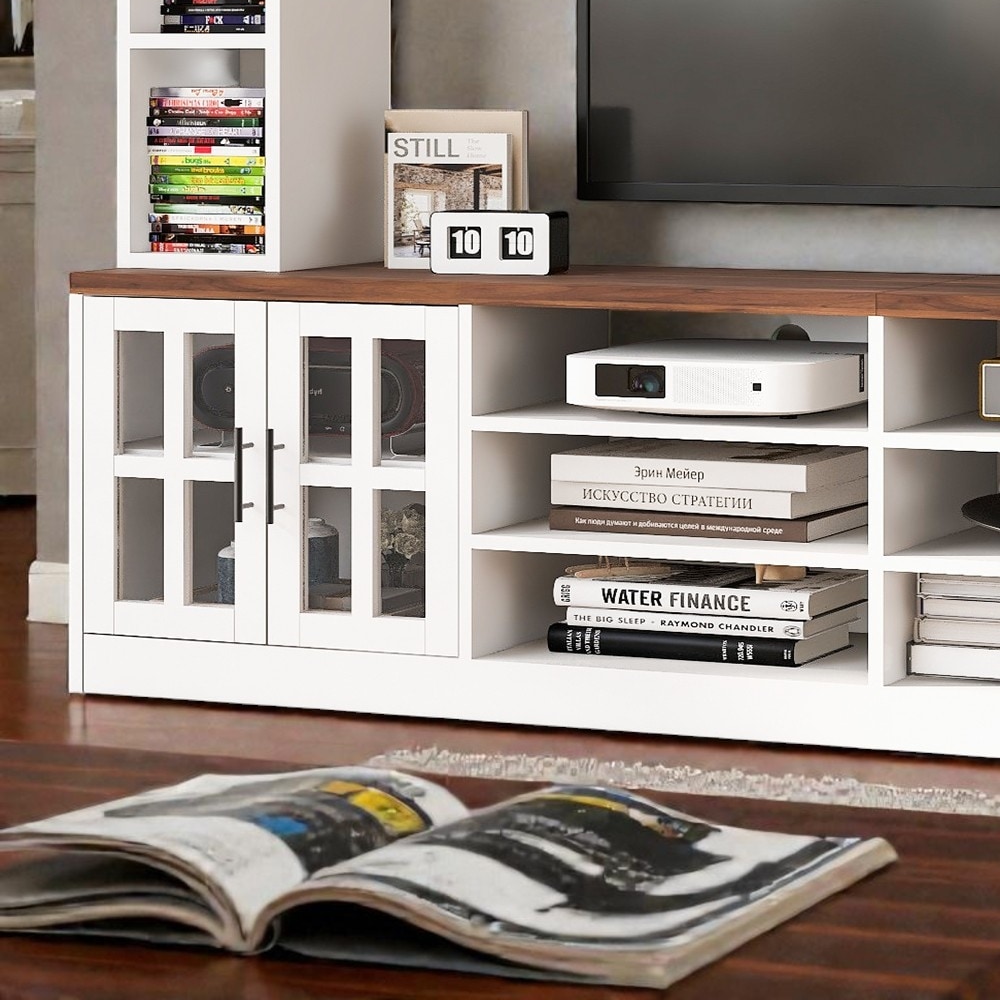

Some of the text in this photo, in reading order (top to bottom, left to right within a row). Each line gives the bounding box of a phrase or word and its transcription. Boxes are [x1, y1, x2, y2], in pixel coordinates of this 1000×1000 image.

[393, 138, 460, 158] STILL
[452, 229, 533, 256] 10 10
[634, 466, 705, 483] Эрин Мейер
[582, 488, 753, 510] ИСКУССТВО СТРАТЕГИИ
[574, 516, 587, 525] Как
[588, 518, 605, 527] люди
[606, 519, 632, 528] думают
[638, 520, 678, 530] добиваются
[679, 522, 699, 531] целей
[706, 524, 762, 534] международной
[762, 527, 784, 536] среде
[601, 587, 751, 612] WATER FINANCE
[573, 614, 592, 622] THE
[617, 617, 646, 625] SLEEP
[660, 619, 714, 630] RAYMOND
[718, 622, 775, 633] CHANDLER
[565, 629, 573, 652] ITALIAN
